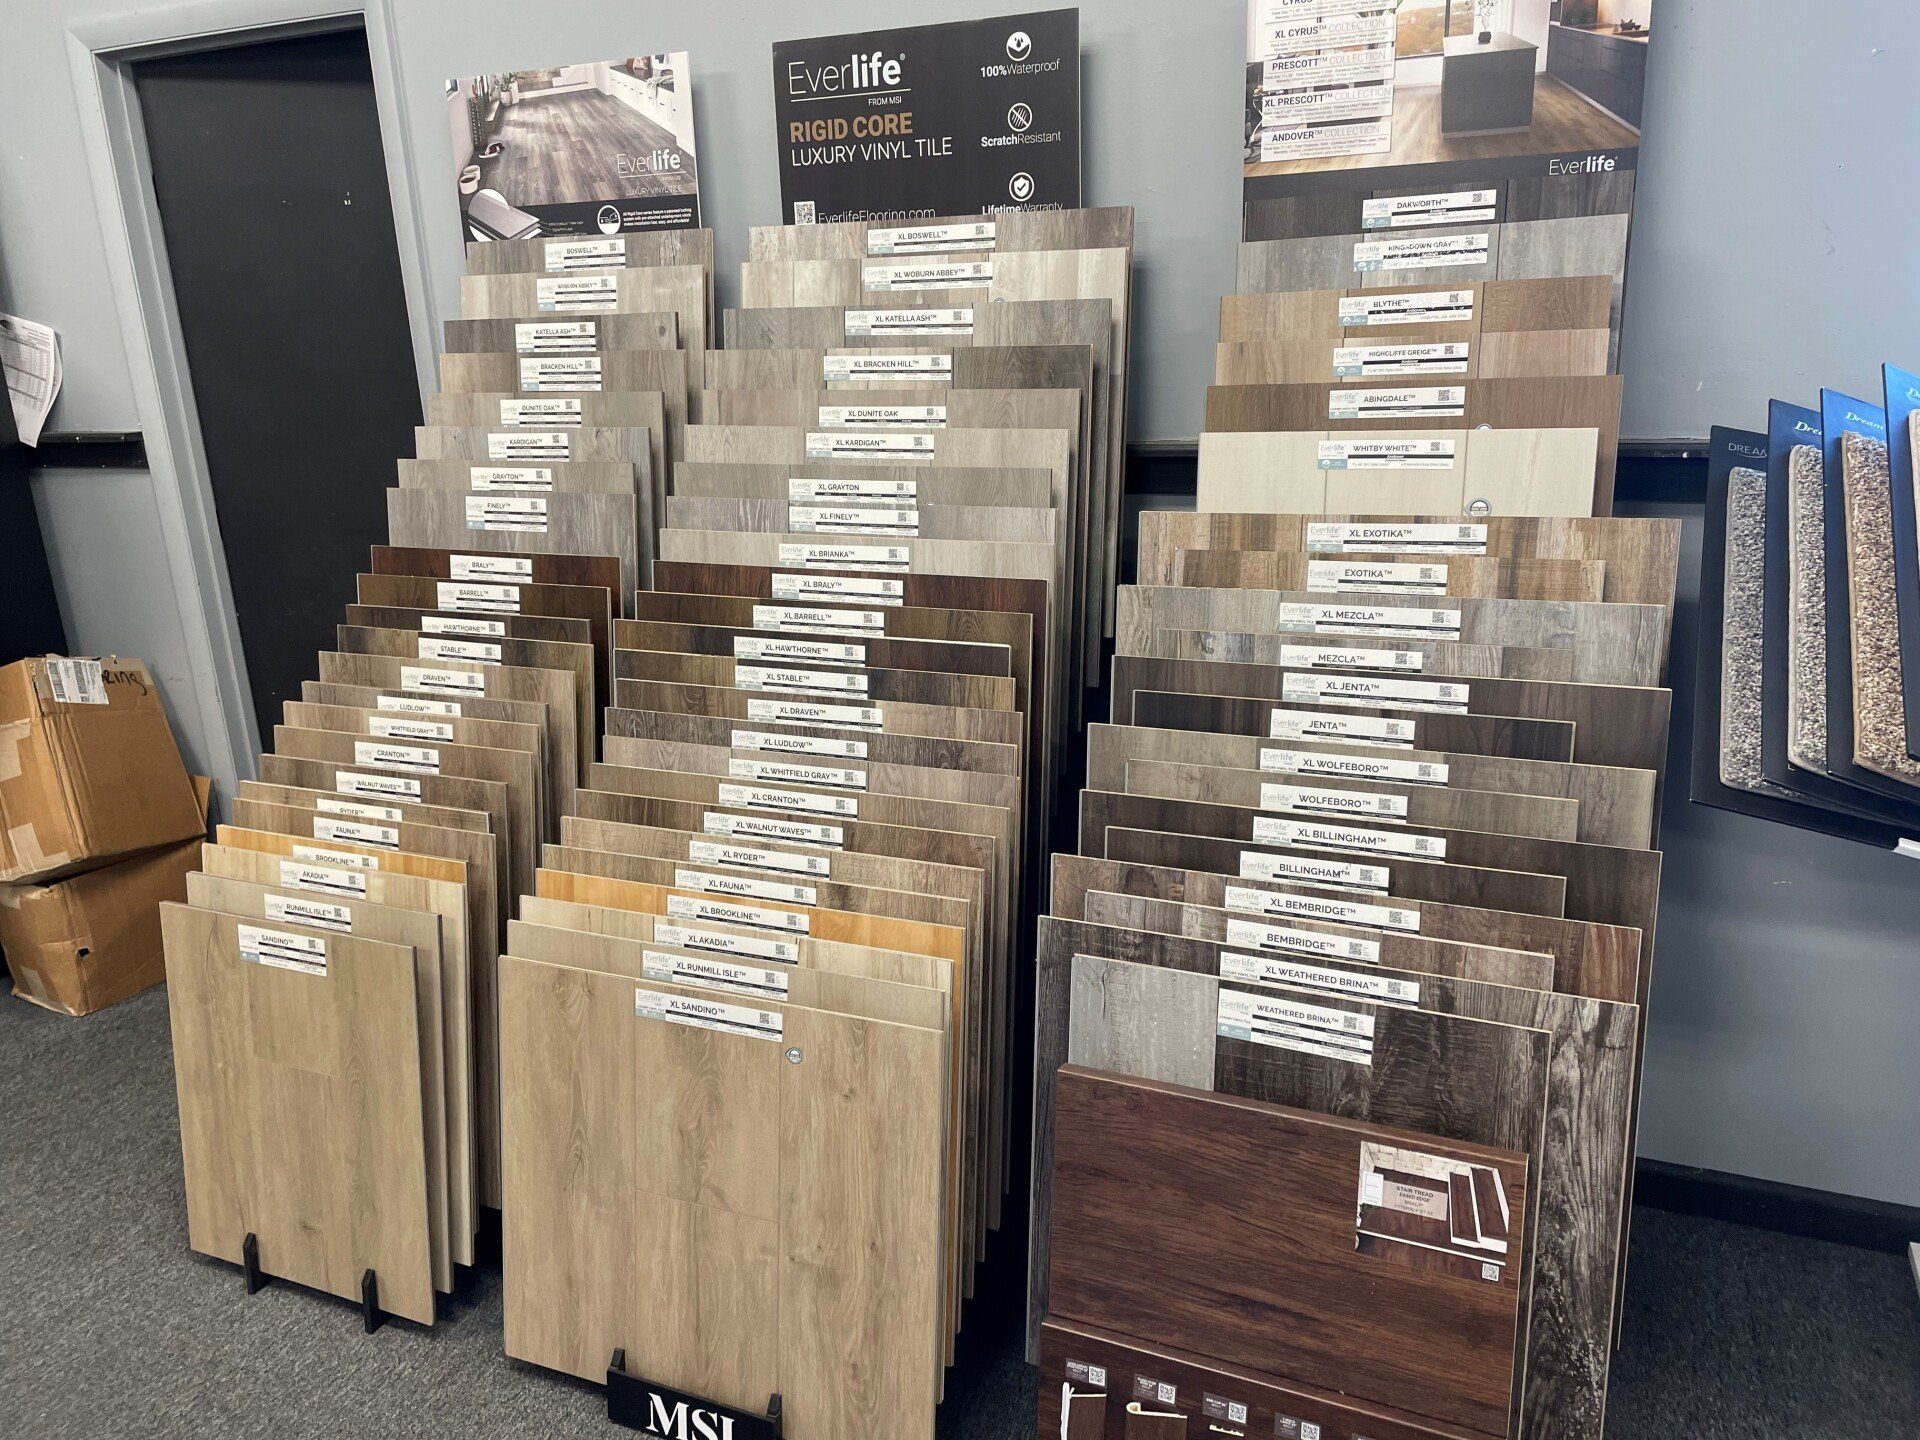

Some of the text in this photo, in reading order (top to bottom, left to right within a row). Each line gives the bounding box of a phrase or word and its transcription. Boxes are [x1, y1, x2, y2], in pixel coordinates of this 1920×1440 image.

[1274, 18, 1386, 39] XL CYRUS™ COLLECTION
[1272, 50, 1386, 71] PRESCOTT™ COLLECTION
[868, 96, 902, 106] FROM MSI
[1264, 87, 1391, 108] XL PRESCOTT™ COLLECTION
[789, 111, 914, 143] RIGID CORE
[1271, 124, 1380, 143] ANDOVER™ COLLECTION
[791, 136, 953, 167] LUXURY VINYL TILE
[1396, 198, 1449, 209] DAKWORTH™
[818, 208, 936, 225] EverlifeFlooring.com
[907, 230, 948, 239] BOSWELL™
[904, 269, 935, 277] WOBURN
[935, 268, 966, 276] ABBEY™
[1373, 299, 1409, 308] BLYTHE™
[1363, 394, 1416, 403] ABINGDALE™
[845, 439, 887, 447] KARDIGAN™
[829, 513, 860, 521] FINELY™
[1349, 529, 1412, 538] XL EXOTIKA™
[818, 550, 855, 558] BRIANKA™
[471, 561, 495, 569] BRALY™
[1344, 569, 1393, 578] EXOTIKA™
[813, 581, 842, 589] BRALY™
[459, 589, 489, 597] BARRELL™
[794, 613, 832, 621] BARRELL™
[1321, 610, 1384, 621] XL MEZCLA™
[443, 624, 486, 632] HAWTHORNE™
[440, 645, 467, 654] STABLE™
[775, 644, 829, 654] HAWTHORNE™
[1318, 654, 1365, 664] MEZCLA™
[776, 673, 810, 683] STABLE™
[1326, 681, 1380, 693] XL JENTA™
[779, 706, 826, 716] XL DRAVEN™
[1308, 720, 1347, 731] JENTA™
[774, 738, 813, 749] LUDLOW™
[377, 749, 410, 758] CRANTON™
[1302, 758, 1389, 773] XL WOLFEBORO™
[760, 766, 838, 780] XL WHITFIELD GRAY™
[762, 794, 806, 804] CRANTON™
[1298, 794, 1371, 808] WOLFEBORO™
[336, 826, 361, 835] FAUNA™
[746, 822, 777, 832] WALNUT
[779, 825, 812, 836] WAVES™
[1298, 828, 1387, 846] XL BILLINGHAM™
[315, 854, 355, 866] BROOKLINE™
[722, 850, 766, 862] XL RYDER™
[302, 871, 329, 880] AKADIA™
[1279, 863, 1350, 878] BILLINGHAM™
[708, 879, 752, 891] XL FAUNA™
[1270, 898, 1356, 916] XL BEMBRIDGE™
[700, 906, 761, 920] XL BROOKLINE™
[261, 935, 294, 945] SANDINO™
[688, 934, 735, 948] XL AKADIA™
[1266, 933, 1335, 950] BEMBRIDGE™
[676, 961, 746, 979] XL RUNMILL ISLE™
[1264, 965, 1379, 990] XL WEATHERED BRINA™
[670, 1000, 726, 1015] XL SANDINO™
[1256, 1004, 1339, 1025] WEATHERED BRINA™
[1396, 1185, 1434, 1198] STAIR TREAD
[1399, 1192, 1416, 1200] EASED
[645, 1392, 735, 1440] MSI
